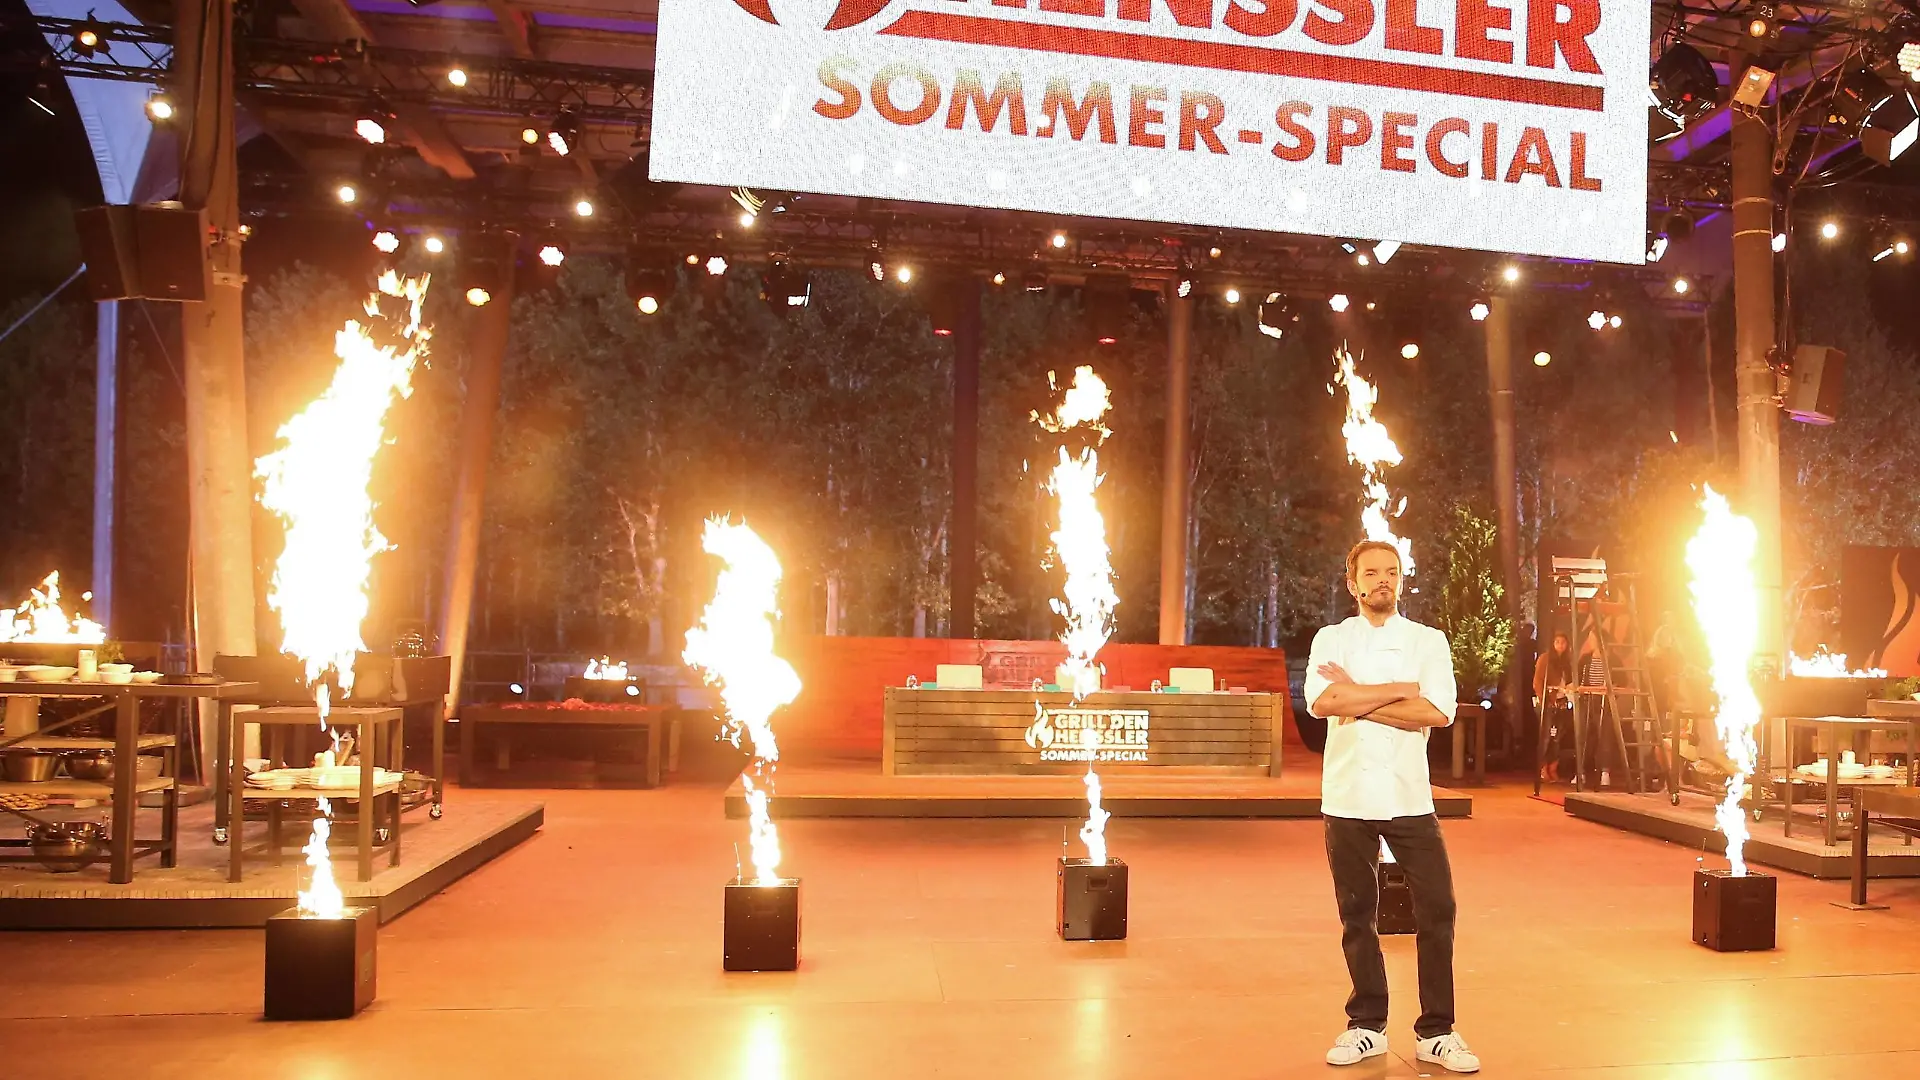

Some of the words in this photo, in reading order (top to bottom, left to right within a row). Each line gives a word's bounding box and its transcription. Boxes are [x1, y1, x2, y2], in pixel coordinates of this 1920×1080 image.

[1759, 5, 1774, 18] 23
[812, 53, 1602, 192] SOMMER-SPECIAL
[1054, 714, 1107, 729] GRILL
[1110, 714, 1149, 730] DEN
[1055, 729, 1149, 744] HESSLER
[1040, 750, 1149, 761] SOMME-SPECIAL
